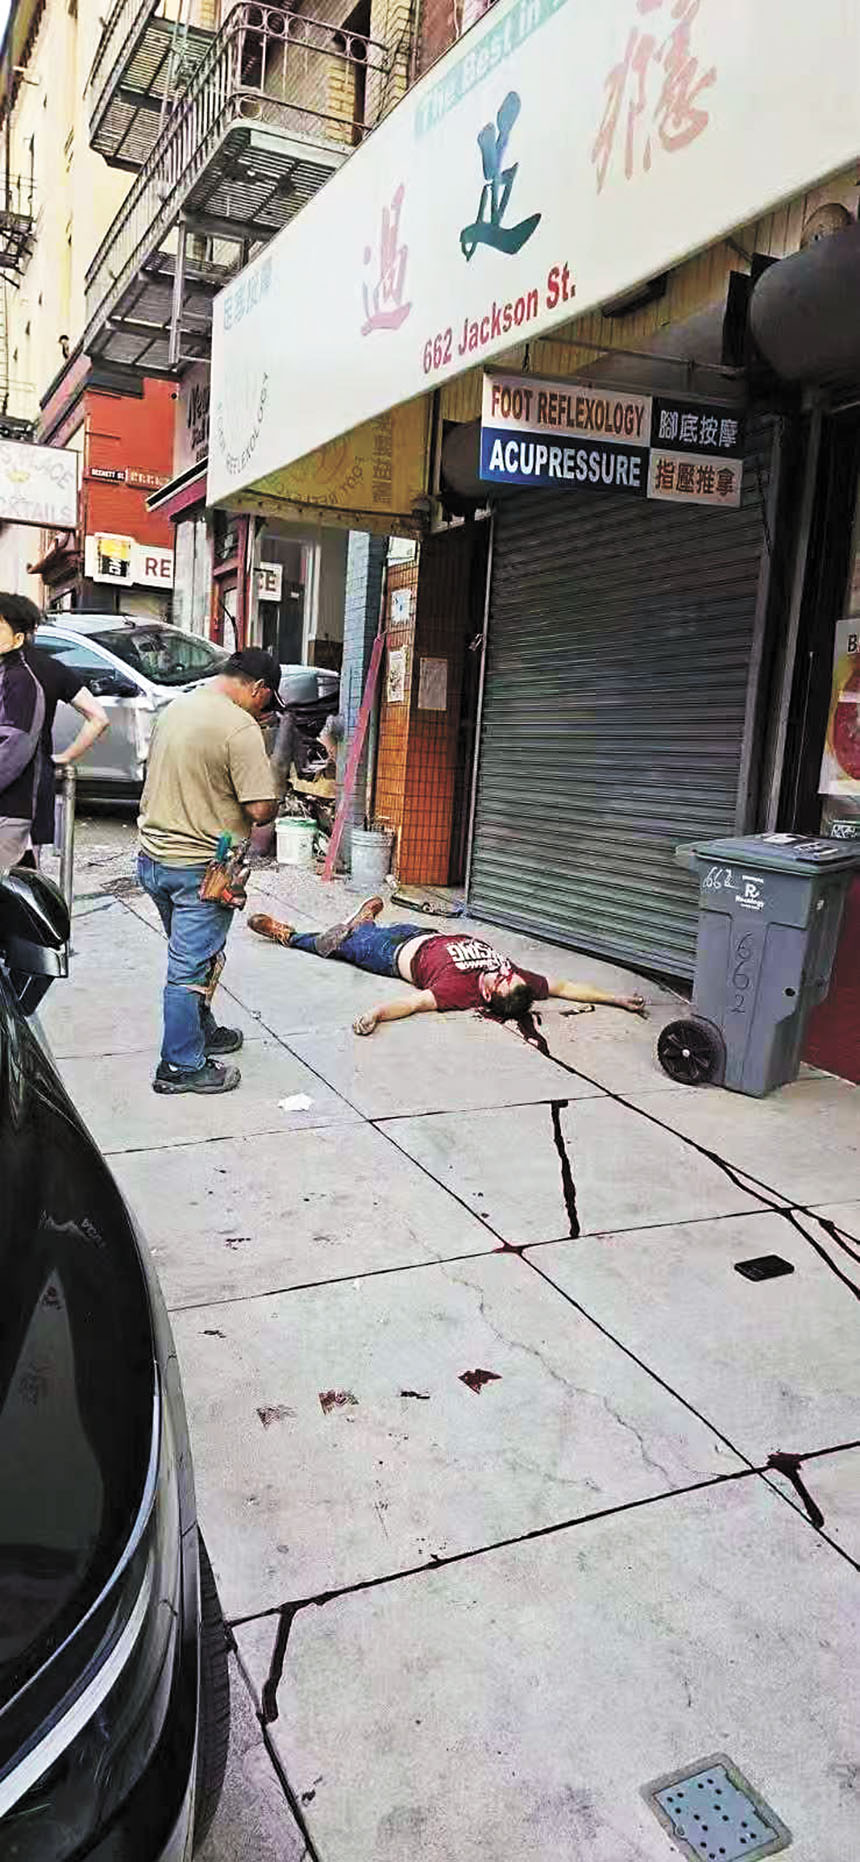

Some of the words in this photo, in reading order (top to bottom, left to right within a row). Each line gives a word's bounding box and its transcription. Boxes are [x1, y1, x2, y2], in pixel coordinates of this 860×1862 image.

[422, 327, 453, 374] 662
[458, 287, 538, 354] Jackson
[547, 261, 577, 310] St.
[491, 384, 534, 421] FOOT
[538, 390, 645, 437] REFLEXOLOGY
[489, 438, 641, 487] ACUPRESSURE
[655, 459, 736, 497] 指壓推拿
[731, 932, 753, 1015] 662
